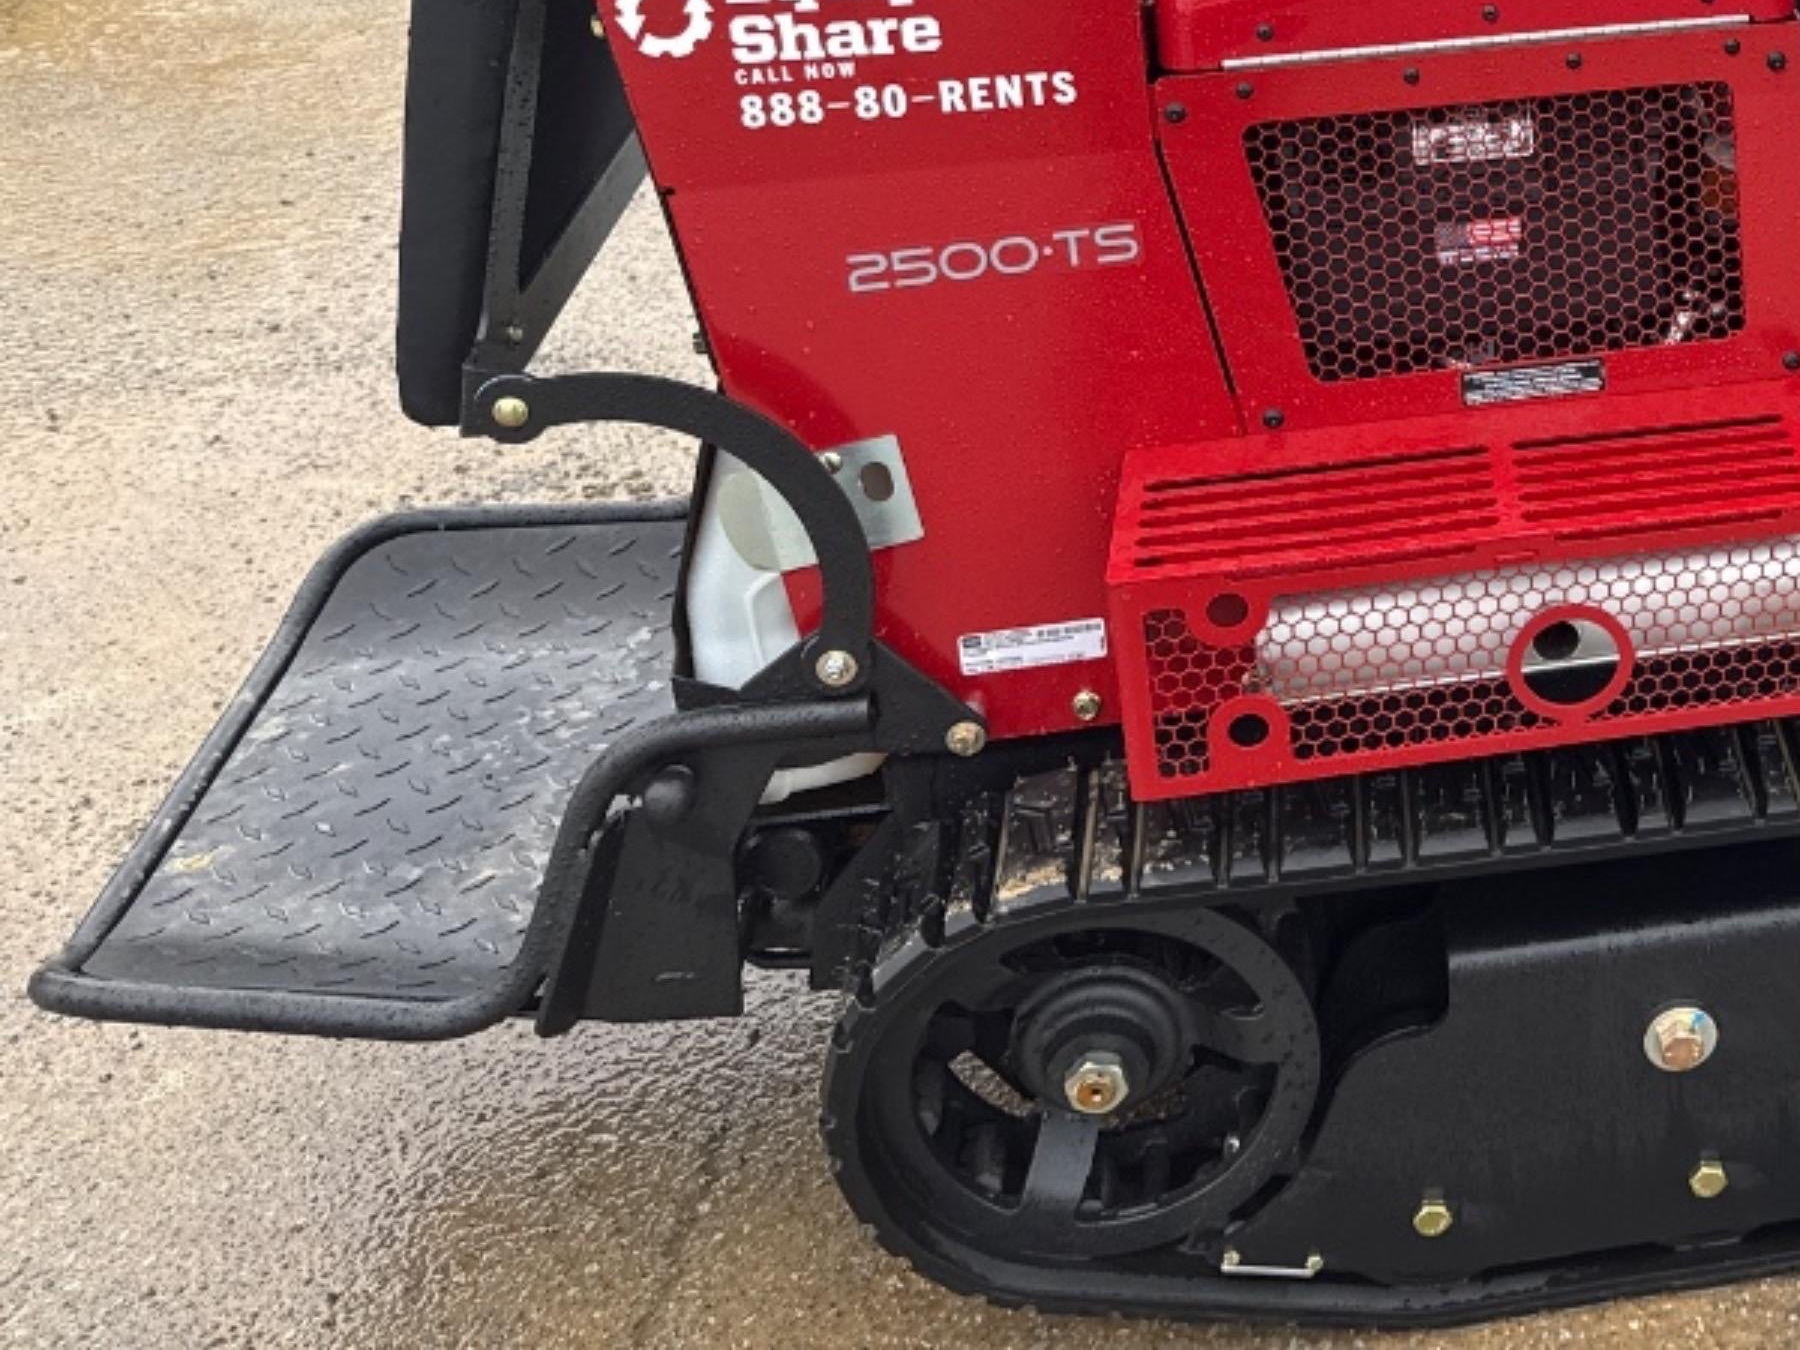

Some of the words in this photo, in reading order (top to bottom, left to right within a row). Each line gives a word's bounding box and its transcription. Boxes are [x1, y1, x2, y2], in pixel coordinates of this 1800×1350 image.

[731, 13, 941, 64] Share
[734, 67, 793, 86] CALL
[804, 61, 857, 80] NOW
[740, 71, 1077, 129] 888-80-RENTS
